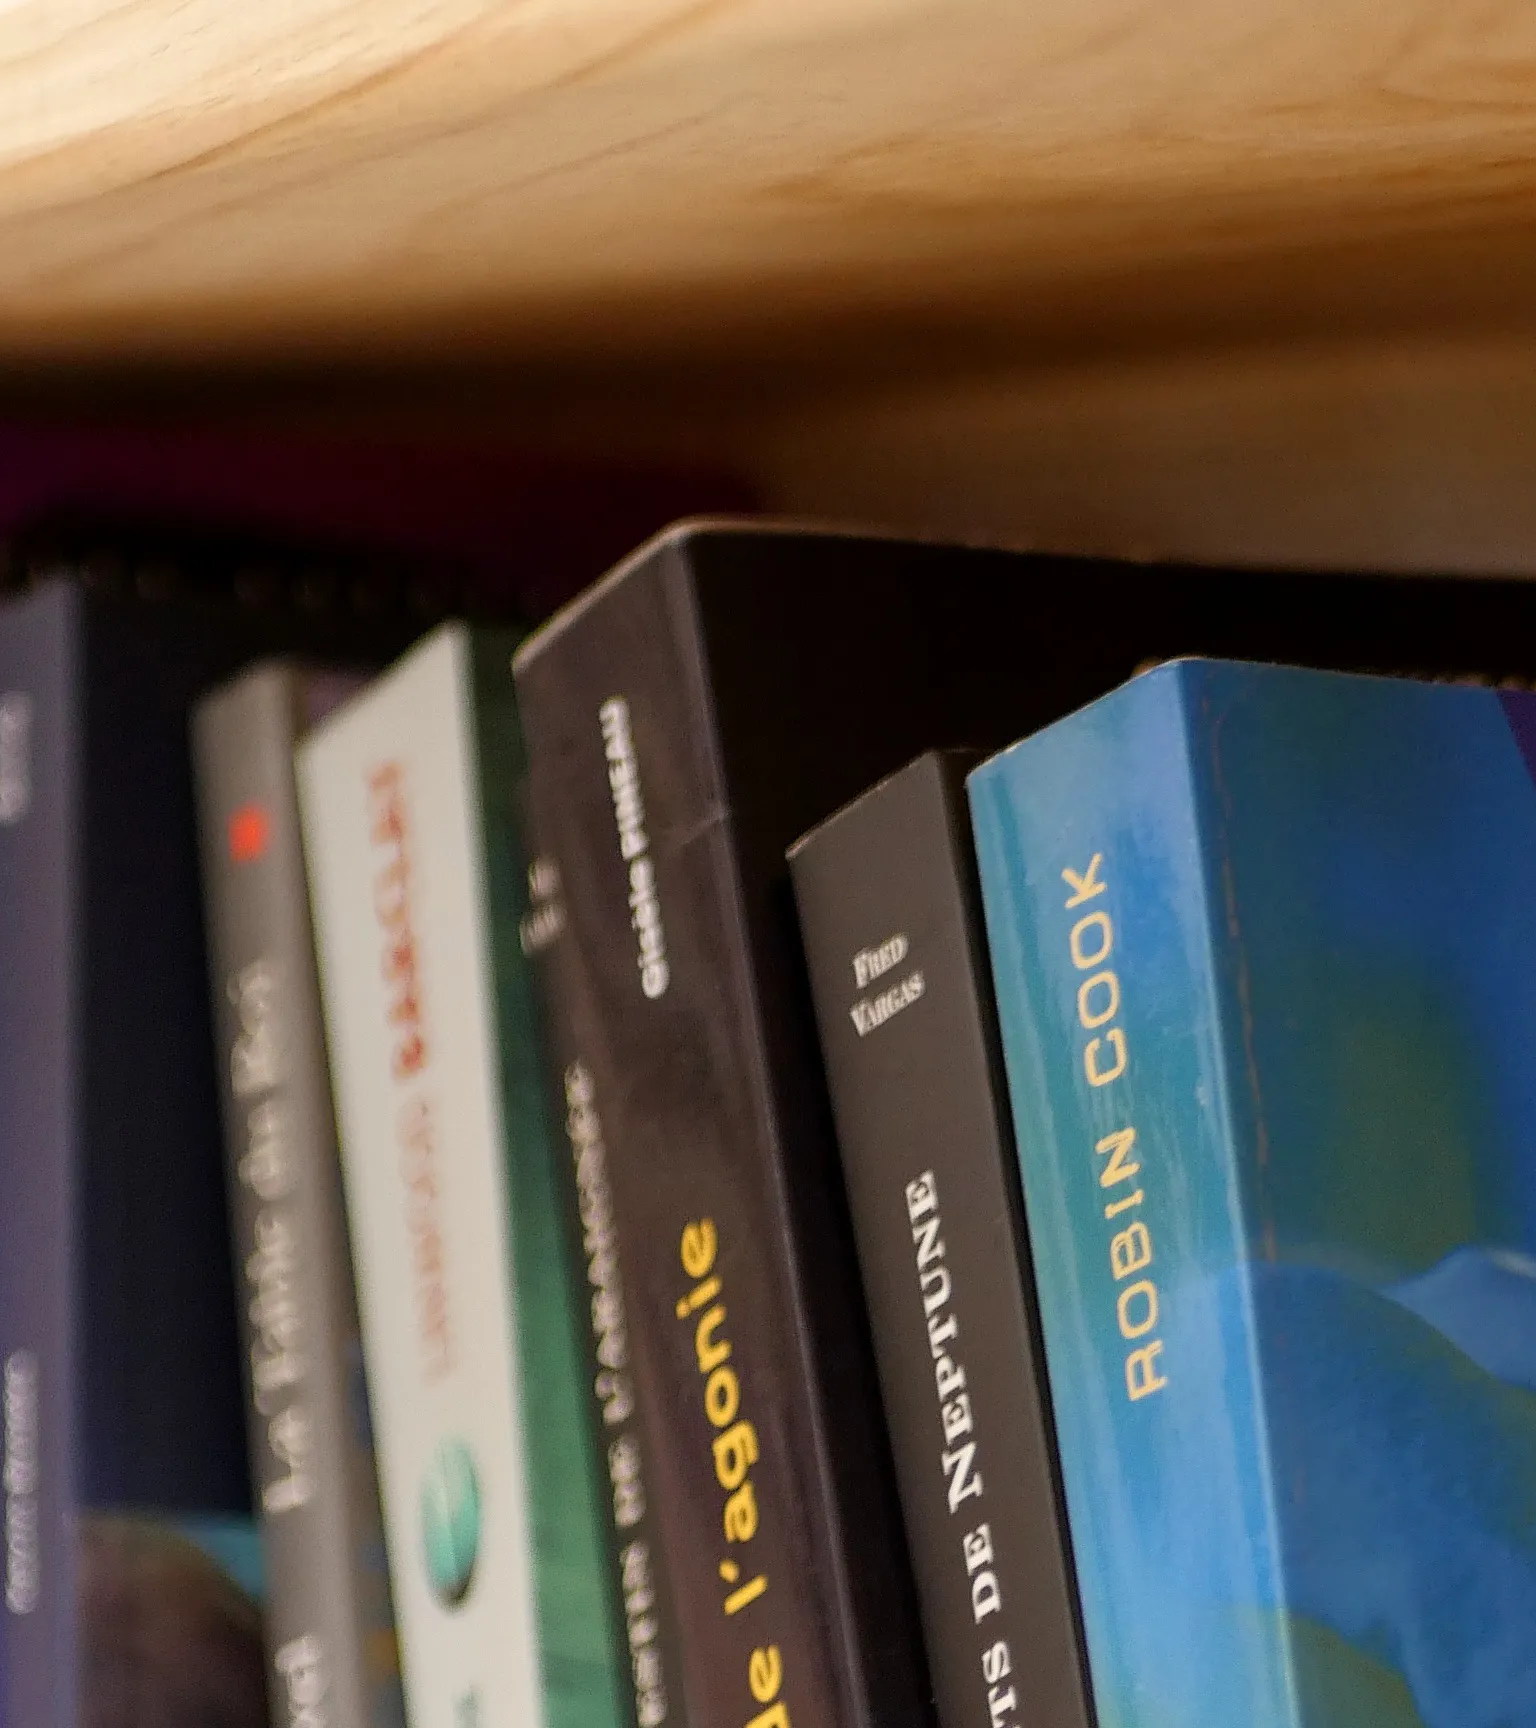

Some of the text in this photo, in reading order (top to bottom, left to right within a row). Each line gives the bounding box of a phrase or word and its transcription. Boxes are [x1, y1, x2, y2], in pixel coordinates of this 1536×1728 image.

[1060, 851, 1171, 1404] ROBIN COOK
[670, 1214, 771, 1617] l'agonie
[902, 1168, 983, 1515] NEPTUNE
[960, 1521, 1003, 1622] DE
